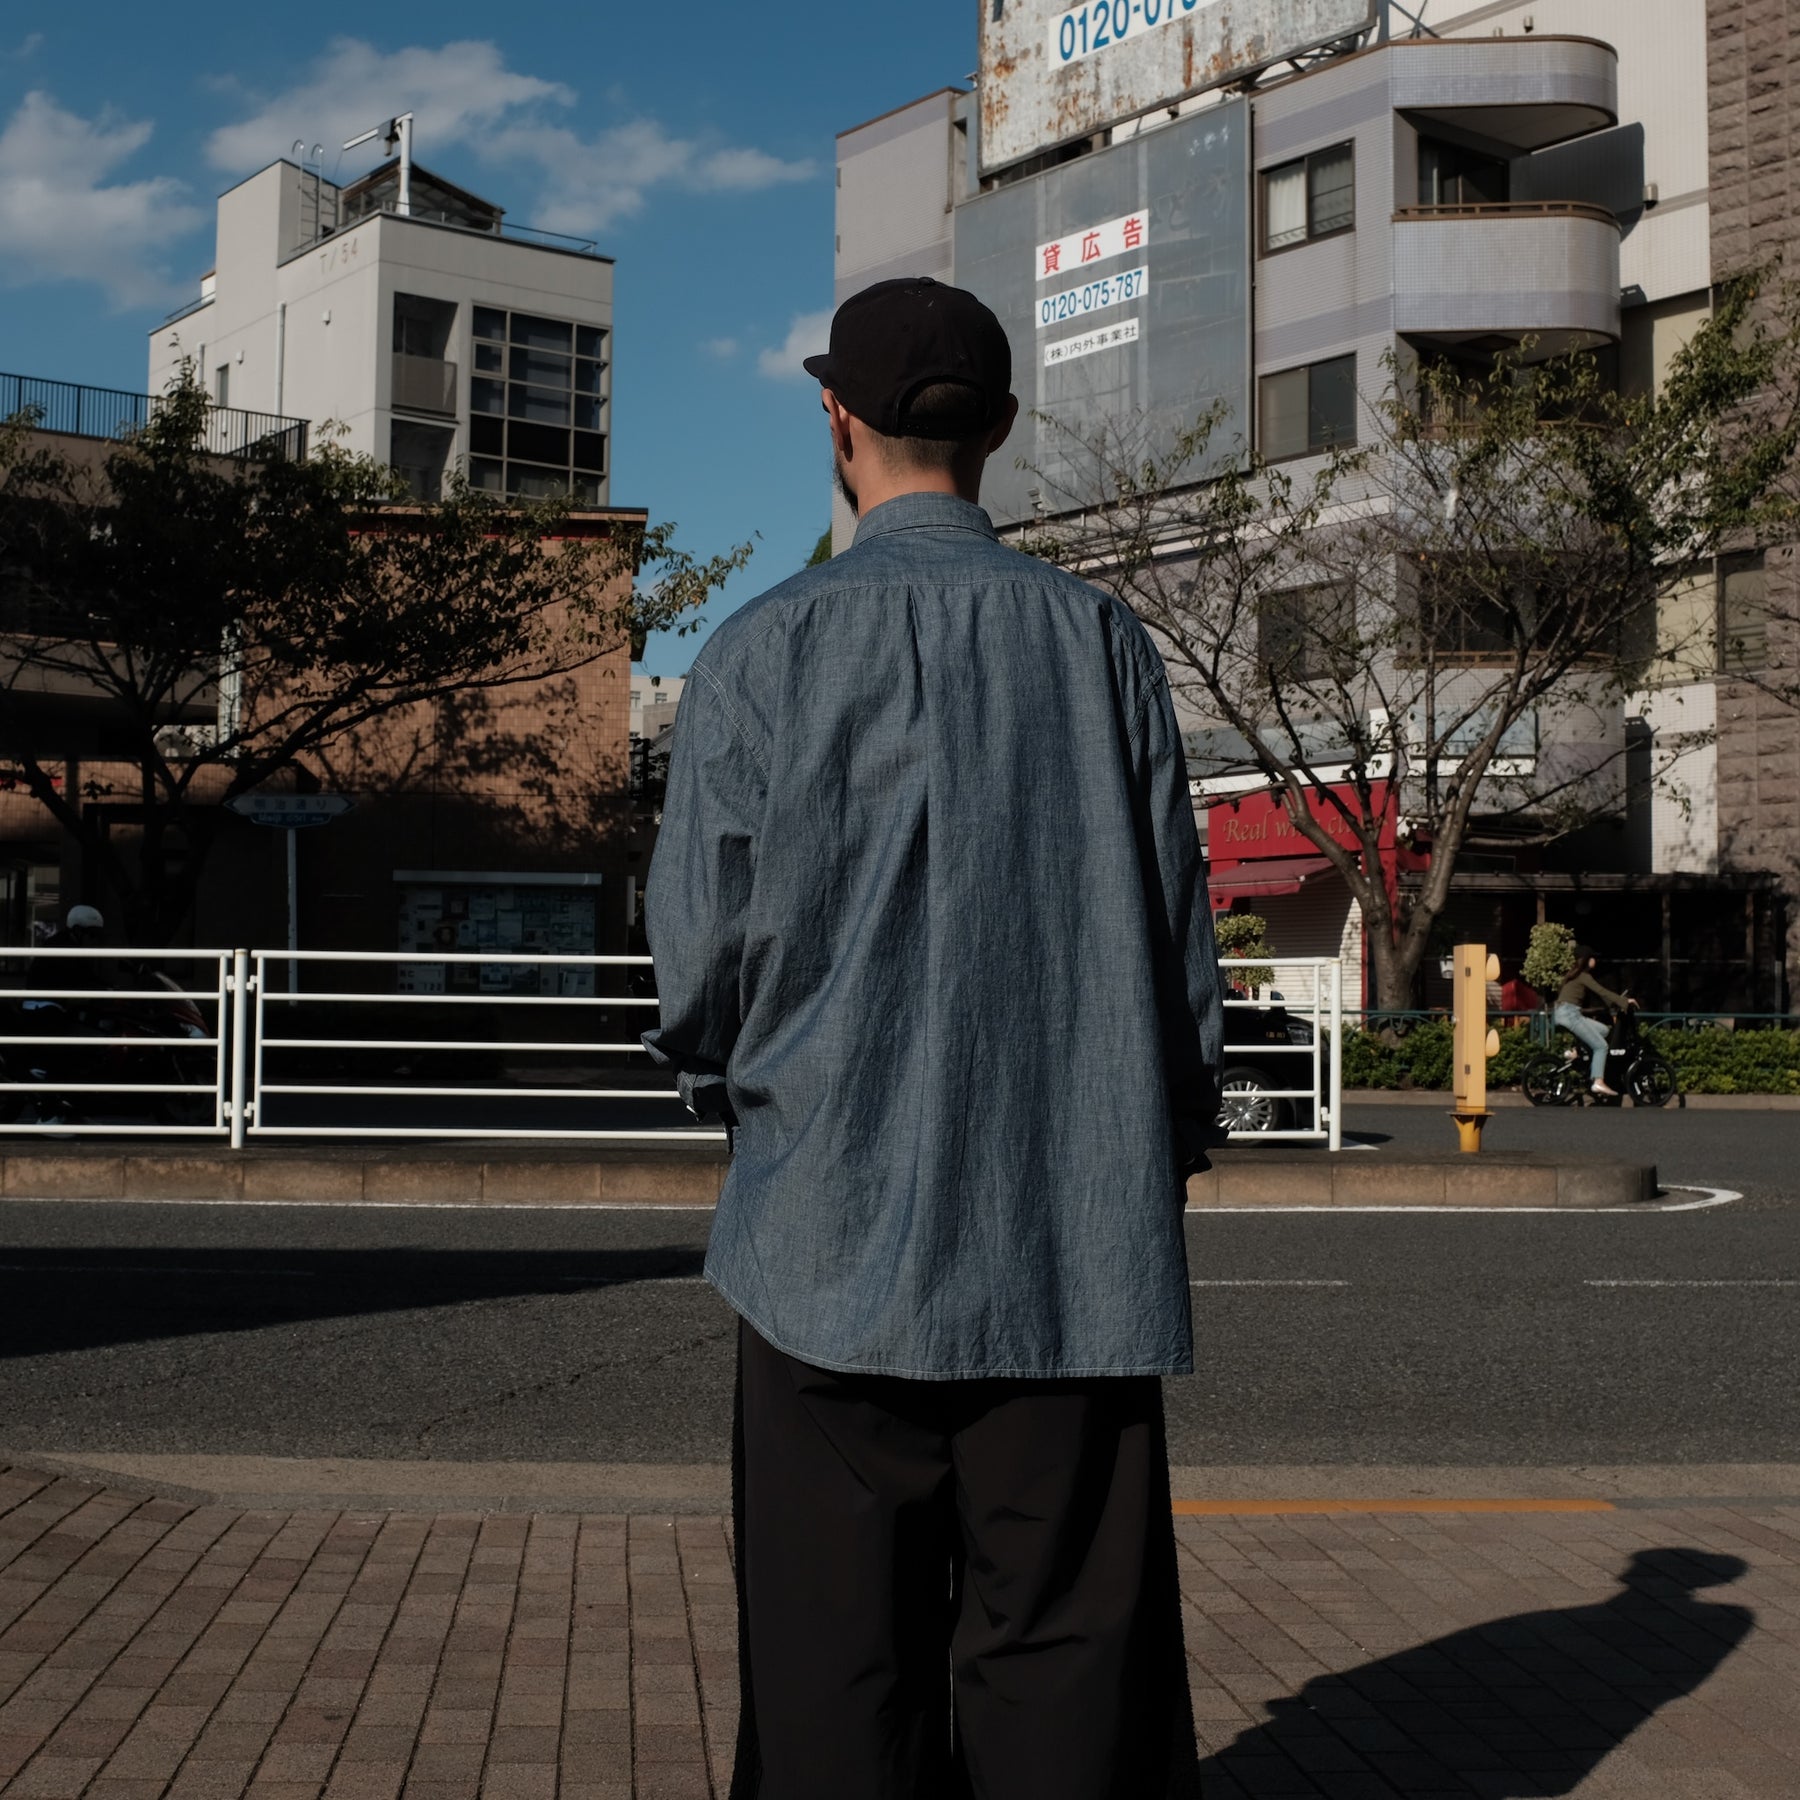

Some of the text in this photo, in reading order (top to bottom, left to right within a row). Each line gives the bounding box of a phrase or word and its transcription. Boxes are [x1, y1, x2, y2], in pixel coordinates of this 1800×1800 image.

[1042, 217, 1143, 275] 貸広告
[1041, 270, 1143, 324] 0120-075-787
[1044, 325, 1137, 363] (株)内外事業社
[1223, 810, 1273, 843] Real
